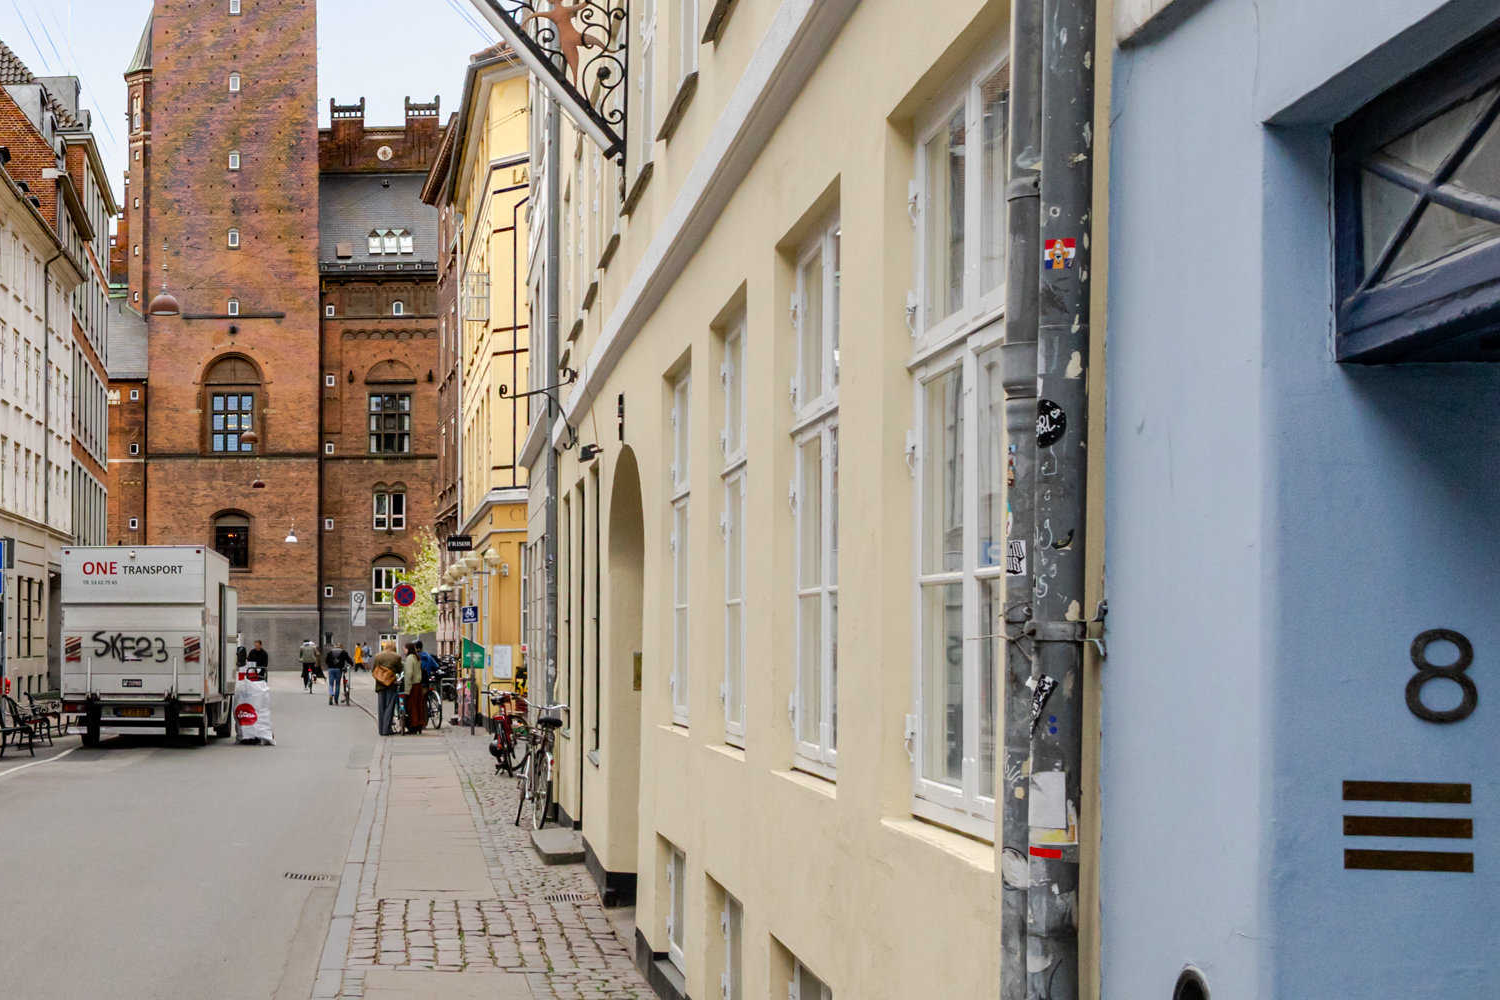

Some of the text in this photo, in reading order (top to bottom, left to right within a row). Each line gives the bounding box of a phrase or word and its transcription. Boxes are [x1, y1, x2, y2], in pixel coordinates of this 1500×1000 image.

[82, 561, 184, 575] ONE TRANSPORT
[1404, 628, 1478, 724] 8
